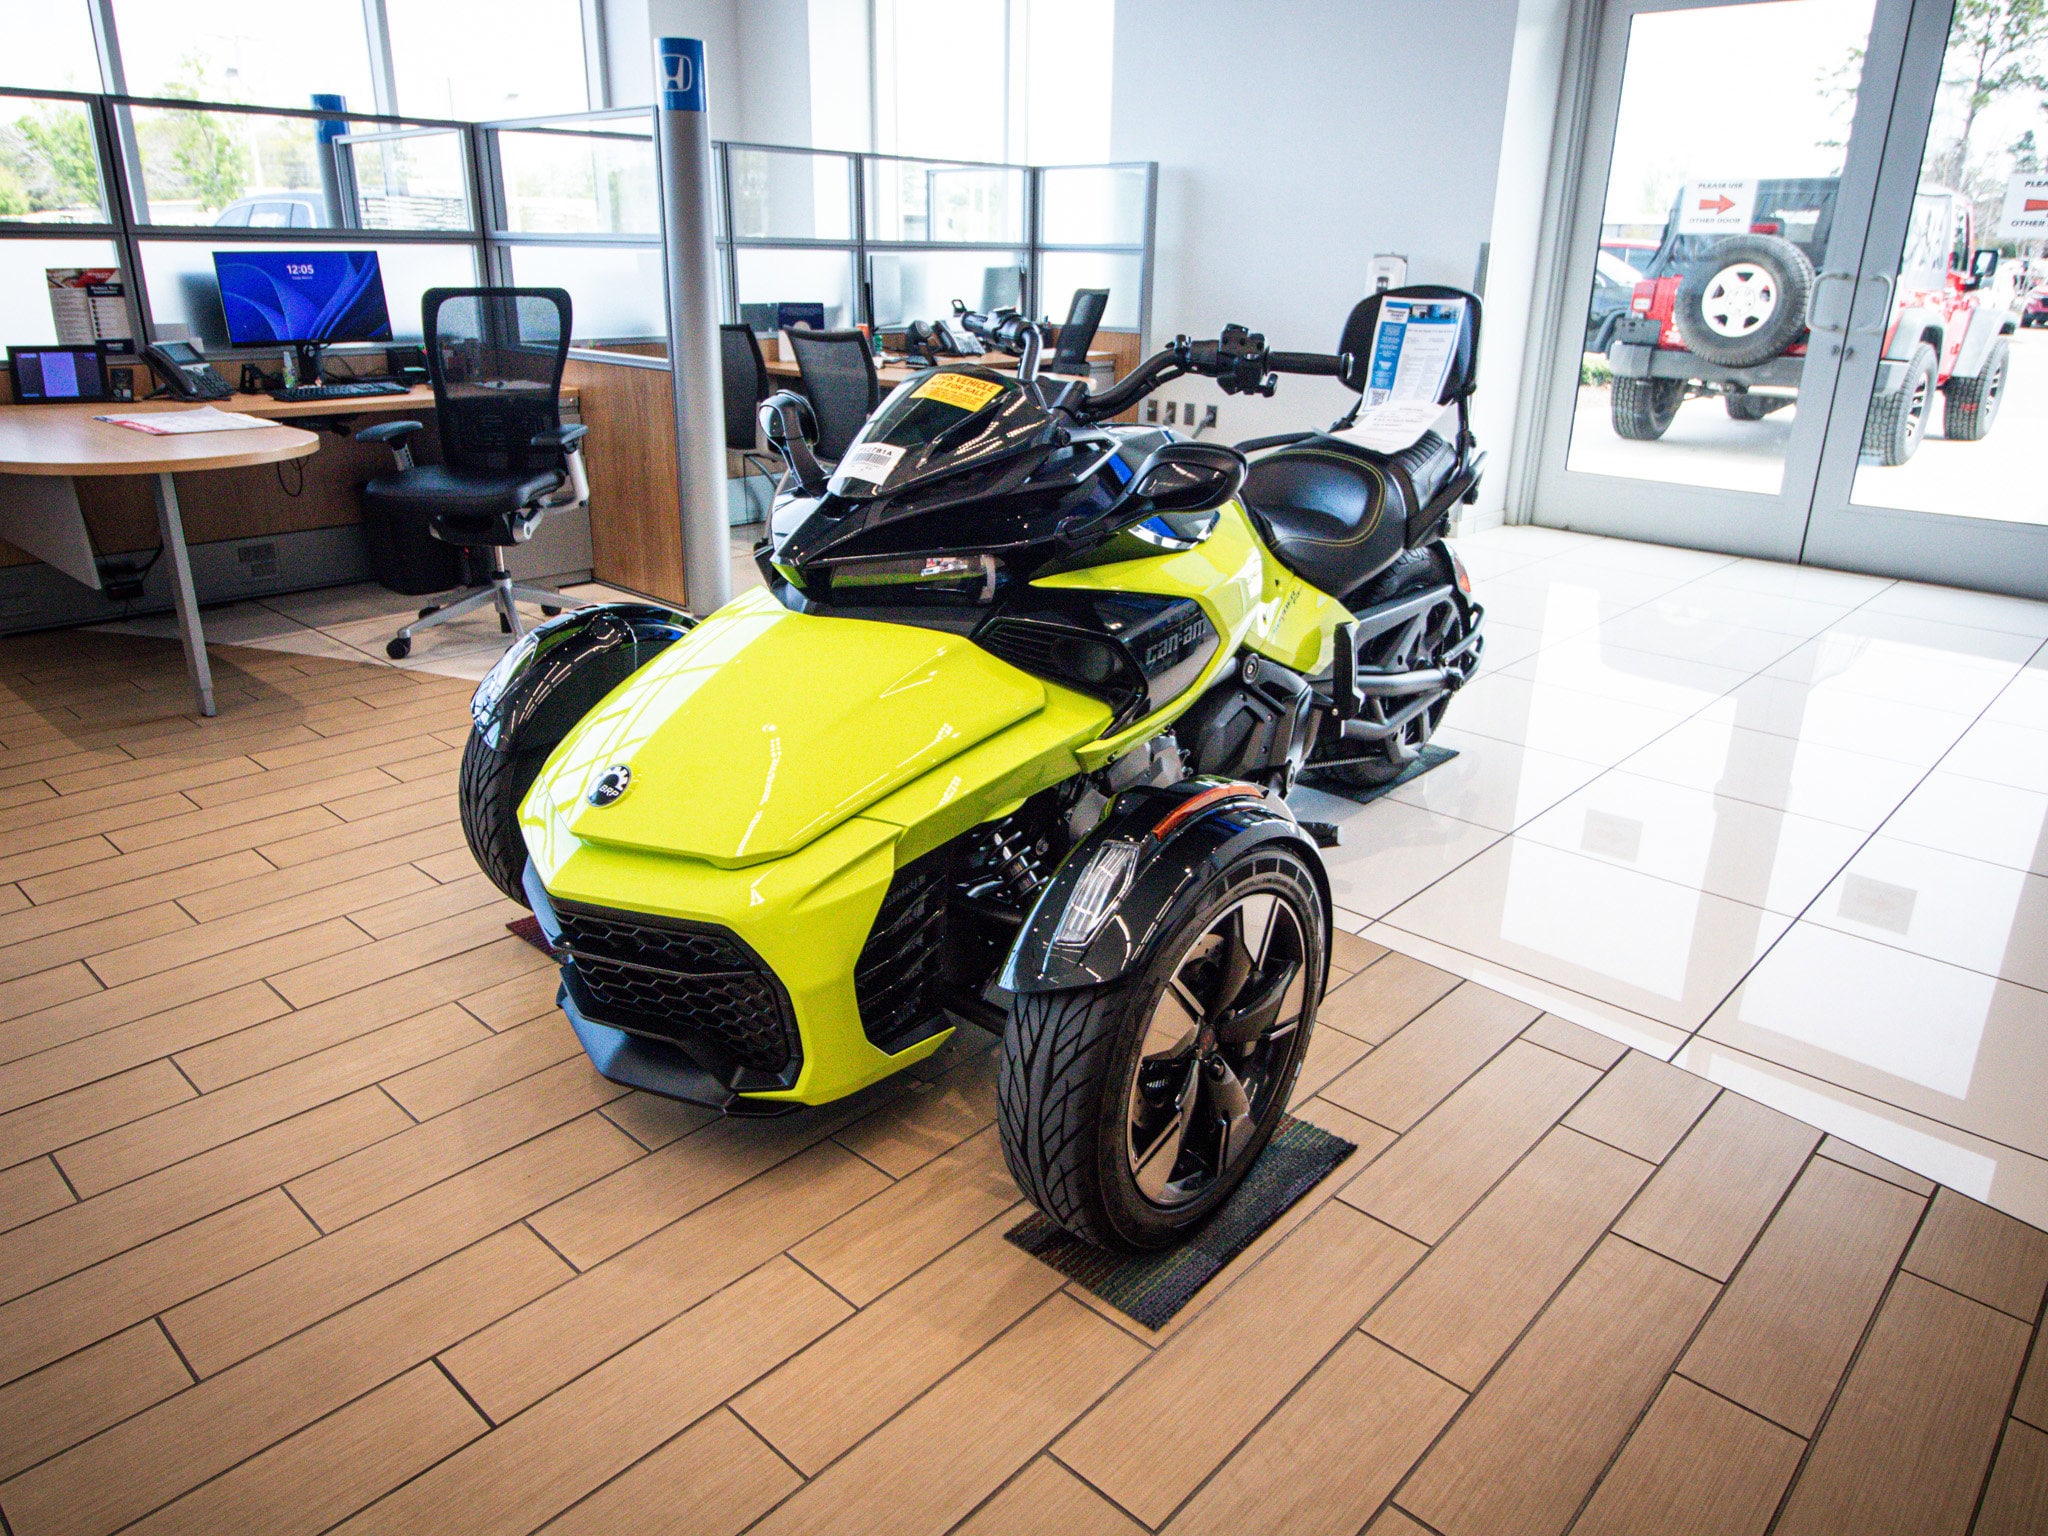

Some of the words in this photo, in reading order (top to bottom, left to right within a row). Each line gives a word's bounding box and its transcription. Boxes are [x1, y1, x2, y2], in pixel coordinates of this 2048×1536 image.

[286, 264, 314, 275] 12:05
[945, 381, 962, 390] FOR
[965, 386, 986, 397] SALE
[956, 376, 996, 393] VEHICLE
[599, 785, 619, 796] BRP
